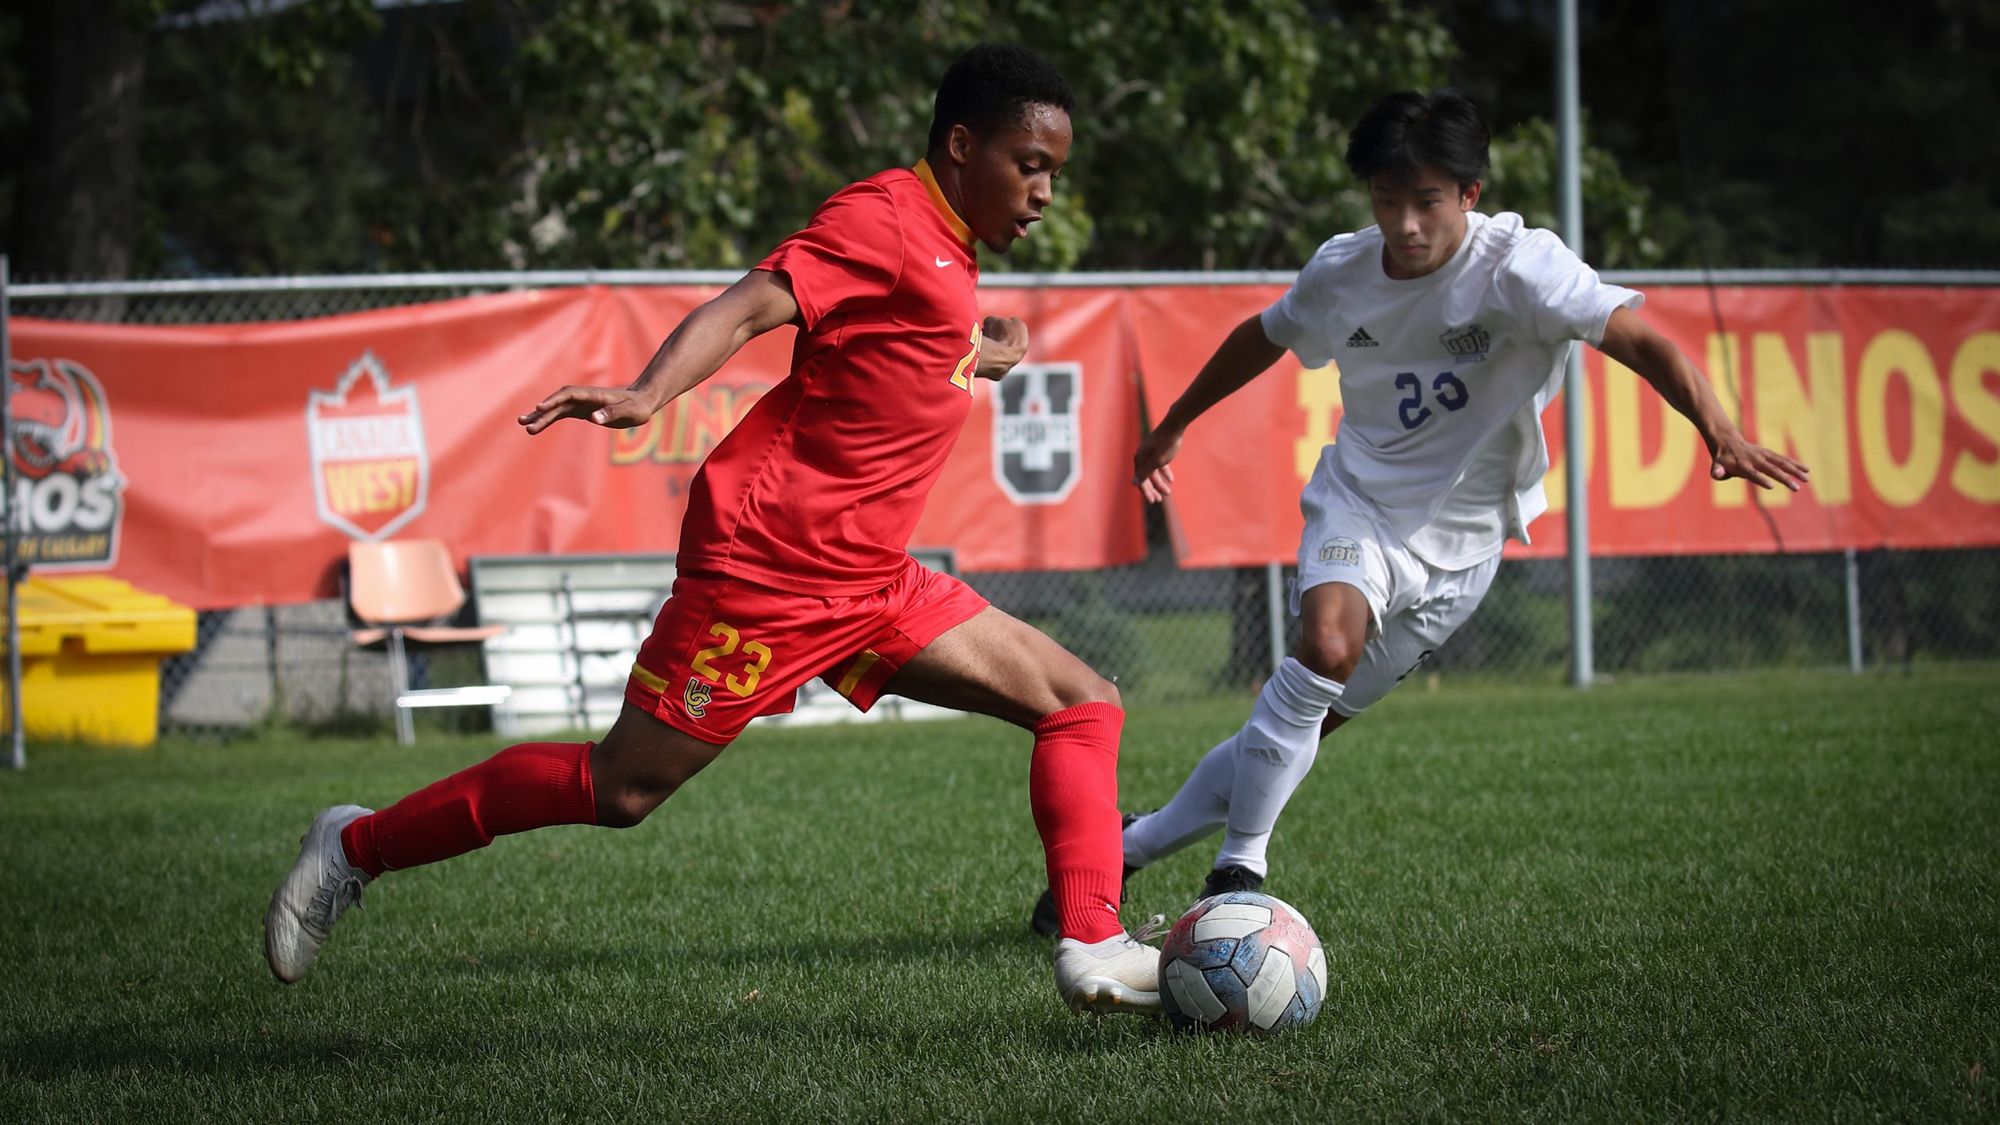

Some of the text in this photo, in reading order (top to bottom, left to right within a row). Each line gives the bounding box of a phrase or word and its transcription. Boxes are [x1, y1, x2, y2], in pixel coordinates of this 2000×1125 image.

[949, 320, 983, 398] 2
[1345, 340, 1380, 348] adidas
[1443, 332, 1490, 355] UBC
[611, 382, 771, 465] DIN
[323, 458, 418, 516] WEST
[1318, 546, 1360, 566] UBC
[690, 622, 773, 698] 23
